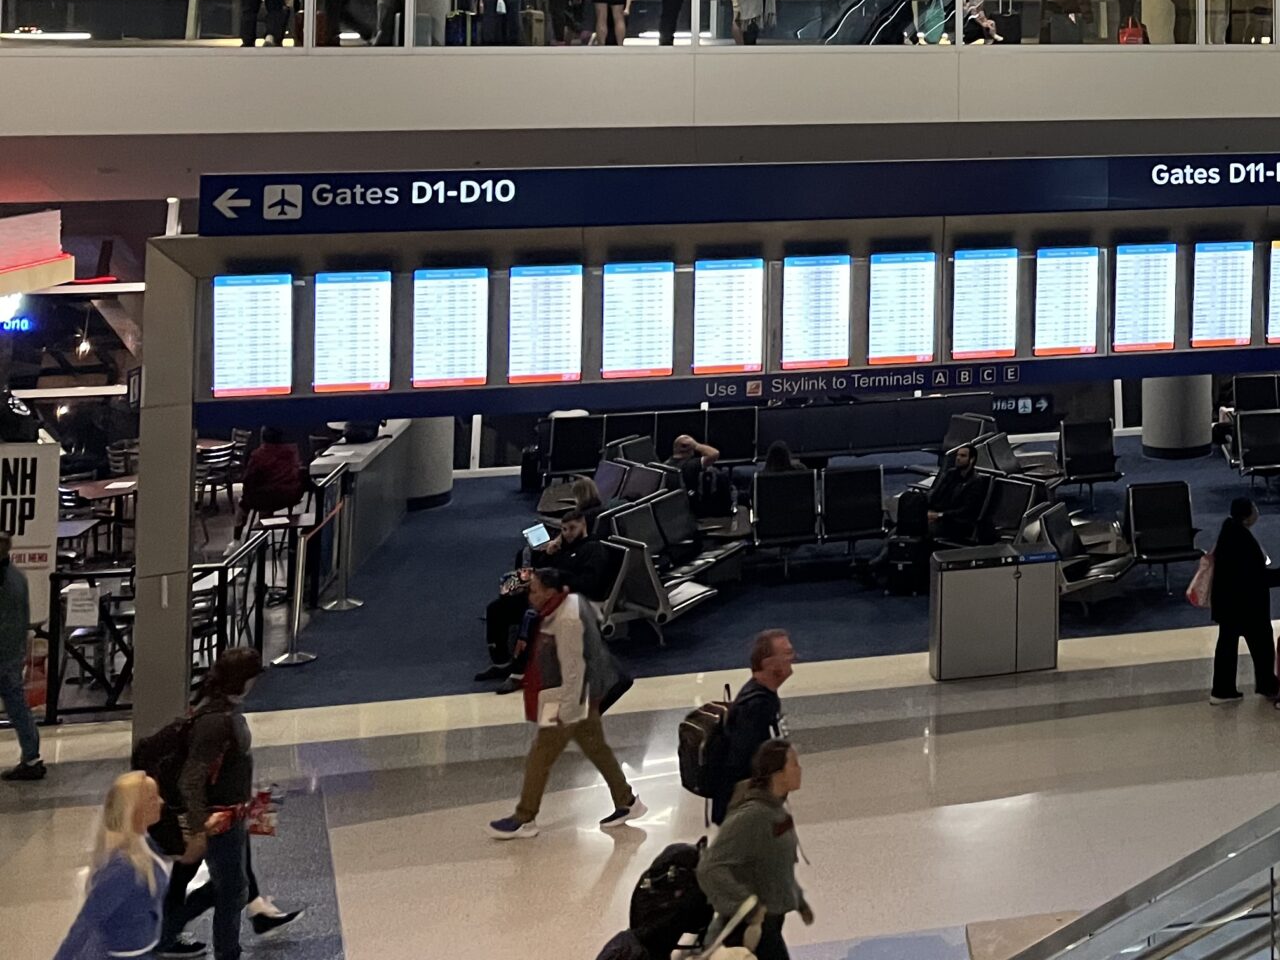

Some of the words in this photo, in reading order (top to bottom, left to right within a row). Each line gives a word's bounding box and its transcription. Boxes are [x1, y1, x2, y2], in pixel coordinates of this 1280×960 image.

[1151, 164, 1221, 185] Gates
[311, 183, 399, 206] Gates
[411, 179, 516, 204] D1-D10
[705, 383, 737, 397] Use
[771, 376, 827, 395] Skylink
[832, 377, 847, 389] to
[851, 371, 925, 388] Terminals
[934, 373, 946, 384] A
[960, 371, 970, 383] B
[983, 369, 994, 381] C
[1007, 368, 1016, 380] E
